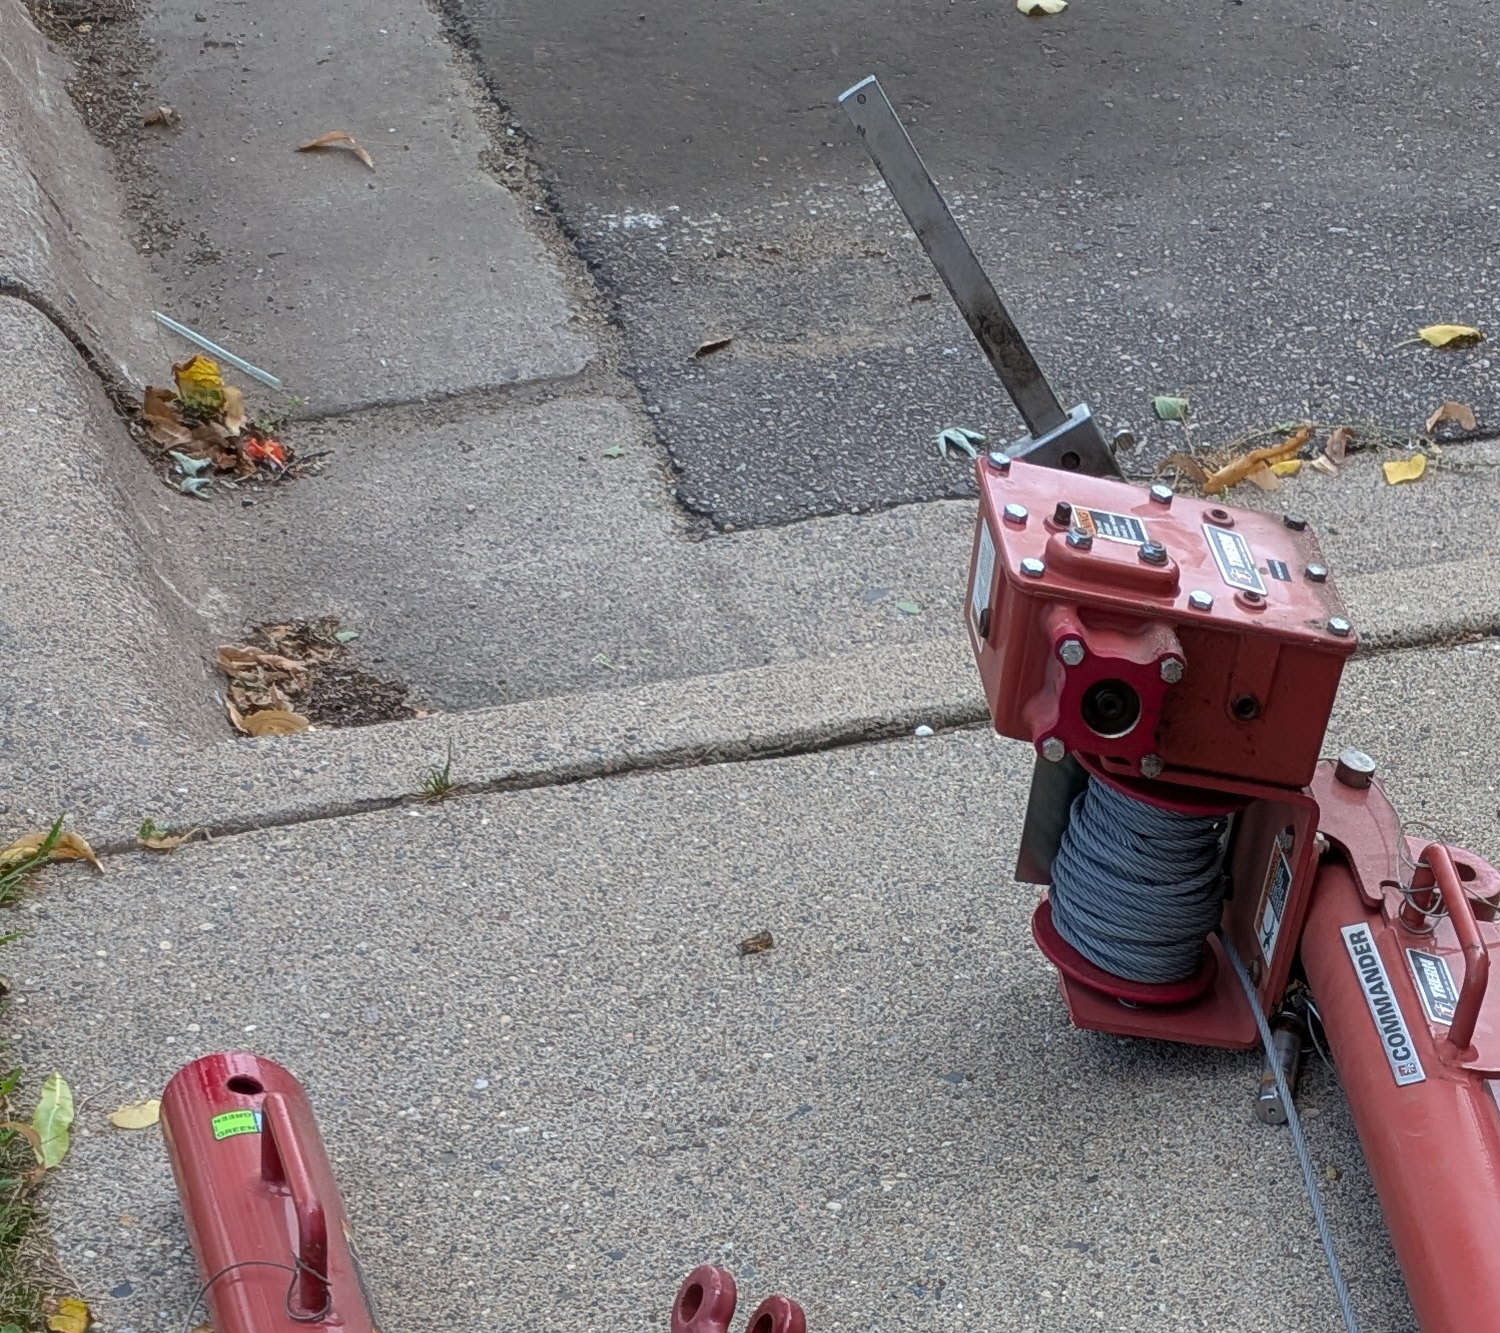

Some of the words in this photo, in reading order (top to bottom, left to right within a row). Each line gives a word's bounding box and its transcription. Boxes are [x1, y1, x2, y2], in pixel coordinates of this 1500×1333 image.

[1418, 957, 1448, 1000] THERN
[1348, 929, 1412, 1062] COMMANDER
[213, 1112, 252, 1124] GREEN
[217, 1125, 256, 1137] GREEN
